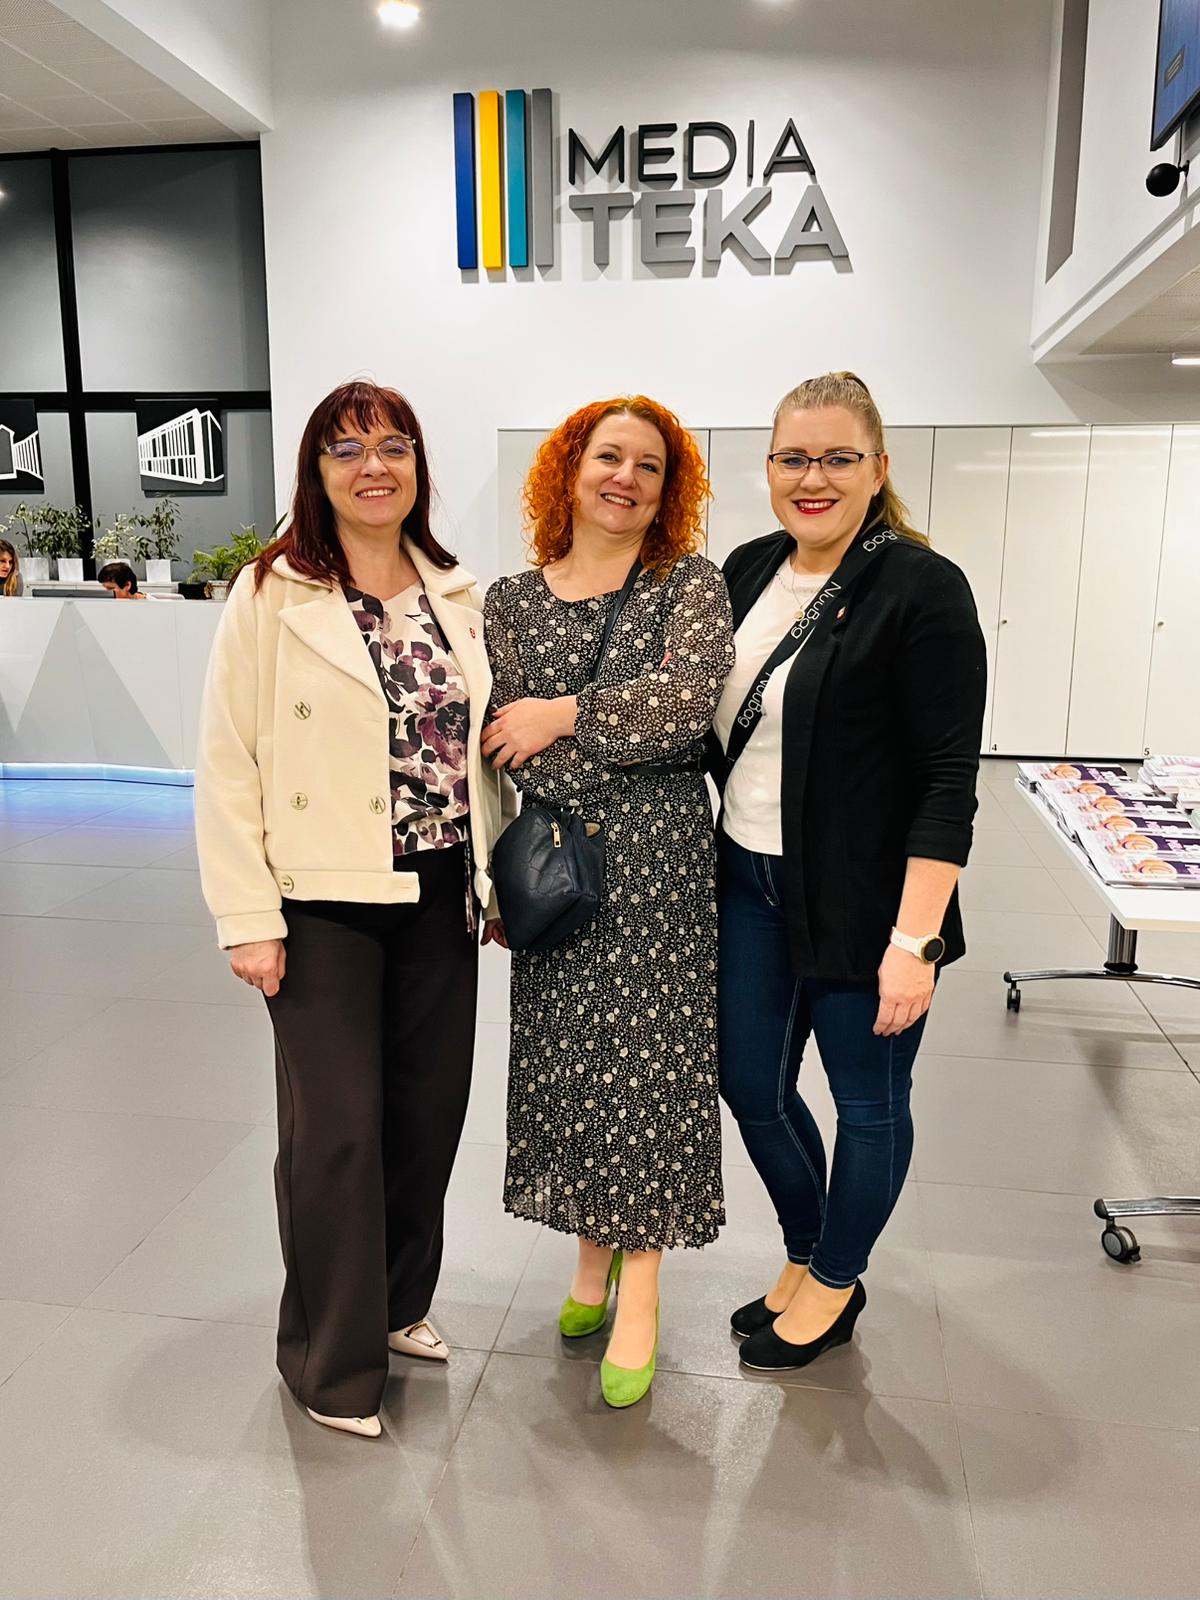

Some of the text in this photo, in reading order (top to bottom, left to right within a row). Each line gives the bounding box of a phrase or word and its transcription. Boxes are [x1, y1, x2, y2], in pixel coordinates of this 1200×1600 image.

[569, 118, 815, 186] MEDIA
[569, 185, 849, 268] TEKA
[790, 580, 842, 639] NuuBag
[991, 743, 998, 752] 4
[1144, 747, 1150, 756] 5
